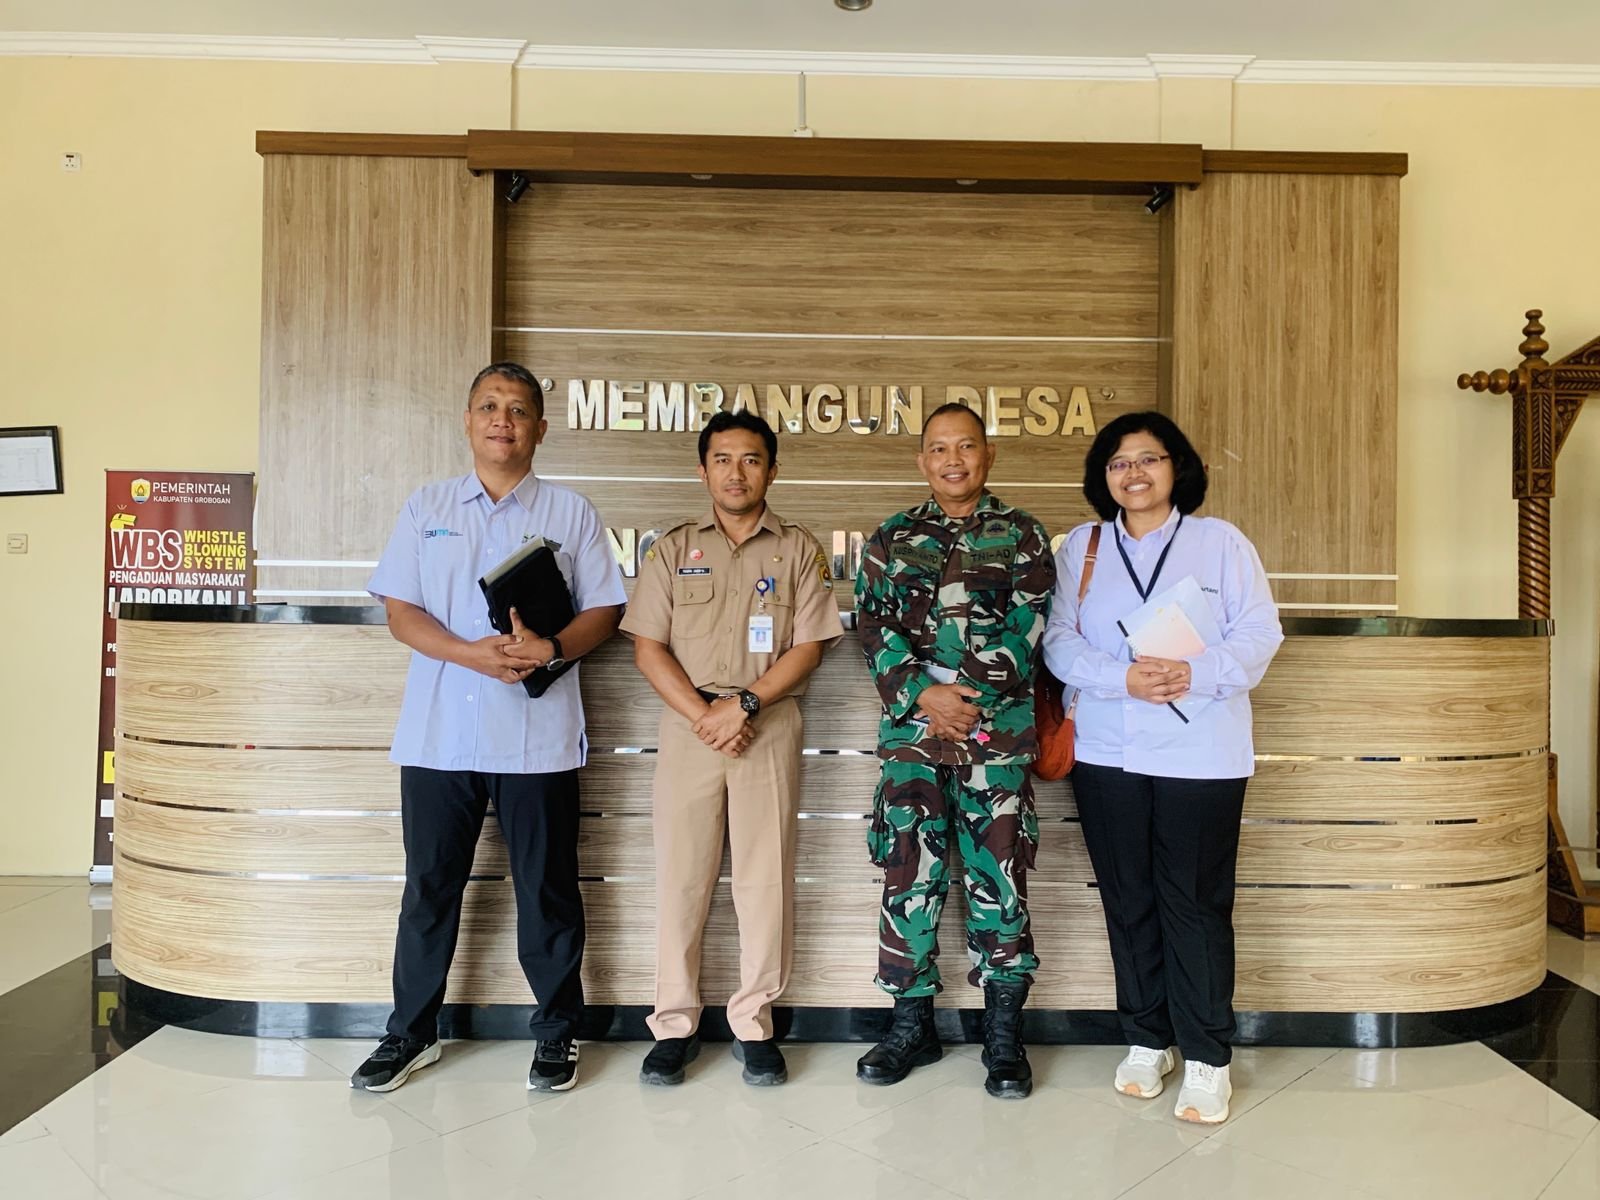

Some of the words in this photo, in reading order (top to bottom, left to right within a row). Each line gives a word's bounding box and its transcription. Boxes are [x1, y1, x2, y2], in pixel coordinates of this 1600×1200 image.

[568, 379, 923, 435] MEMBANGUN
[152, 482, 231, 495] PEMERINTAH
[184, 530, 246, 545] WHISTLE
[110, 529, 183, 570] WBS
[184, 544, 247, 558] BLOWING
[970, 548, 1011, 562] TNI-AD
[184, 557, 246, 571] SYSTEM
[109, 571, 172, 585] PENGADUAN
[175, 572, 246, 587] MASYARAKAT
